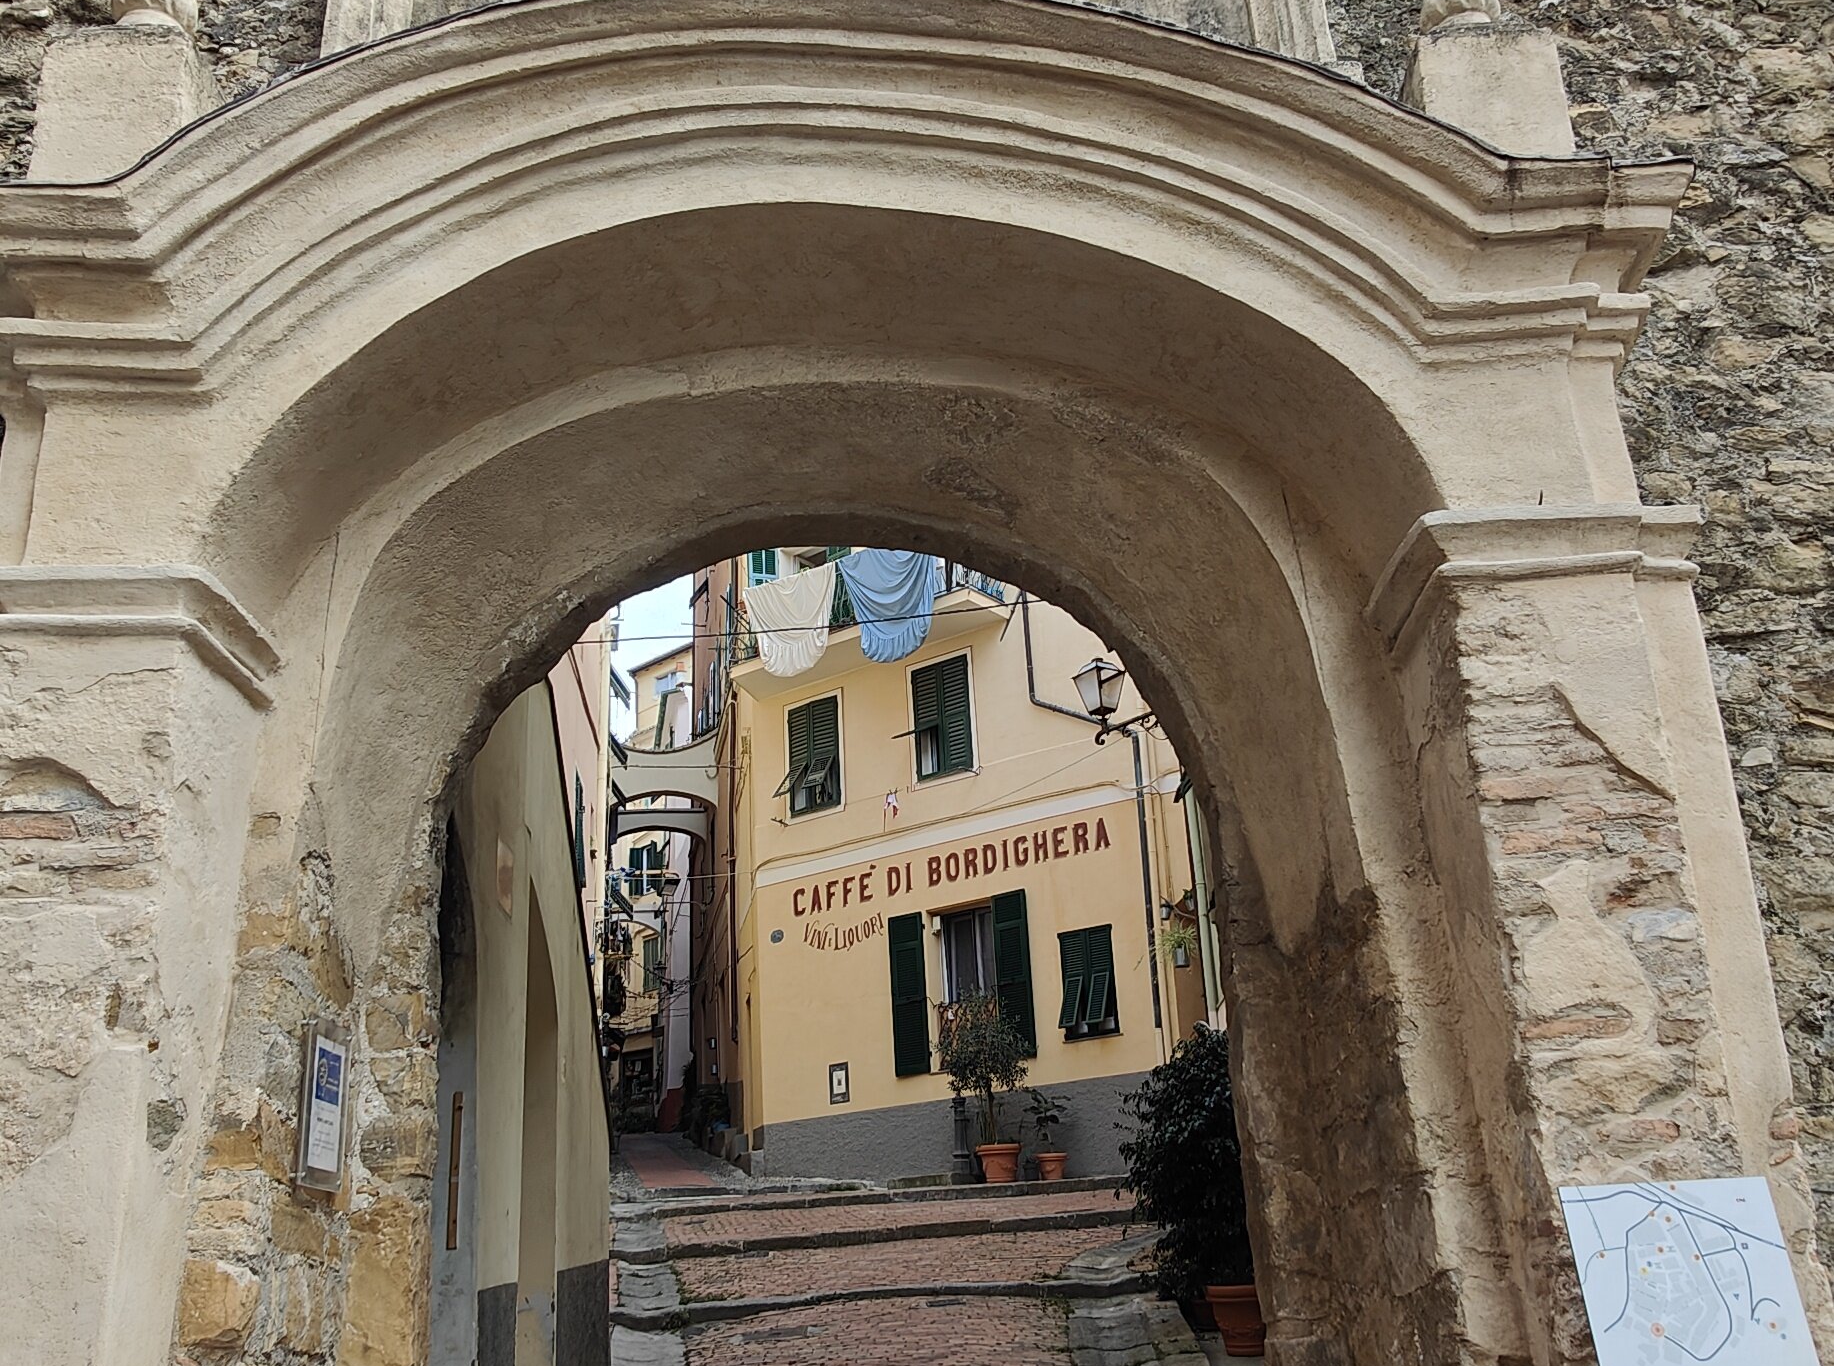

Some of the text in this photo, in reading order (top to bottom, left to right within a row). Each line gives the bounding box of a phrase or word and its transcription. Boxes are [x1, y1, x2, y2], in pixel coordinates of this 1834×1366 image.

[887, 861, 912, 897] DI
[927, 817, 1111, 887] BORDIGHERA
[803, 920, 834, 950] VINI
[834, 911, 884, 952] LIQUORI
